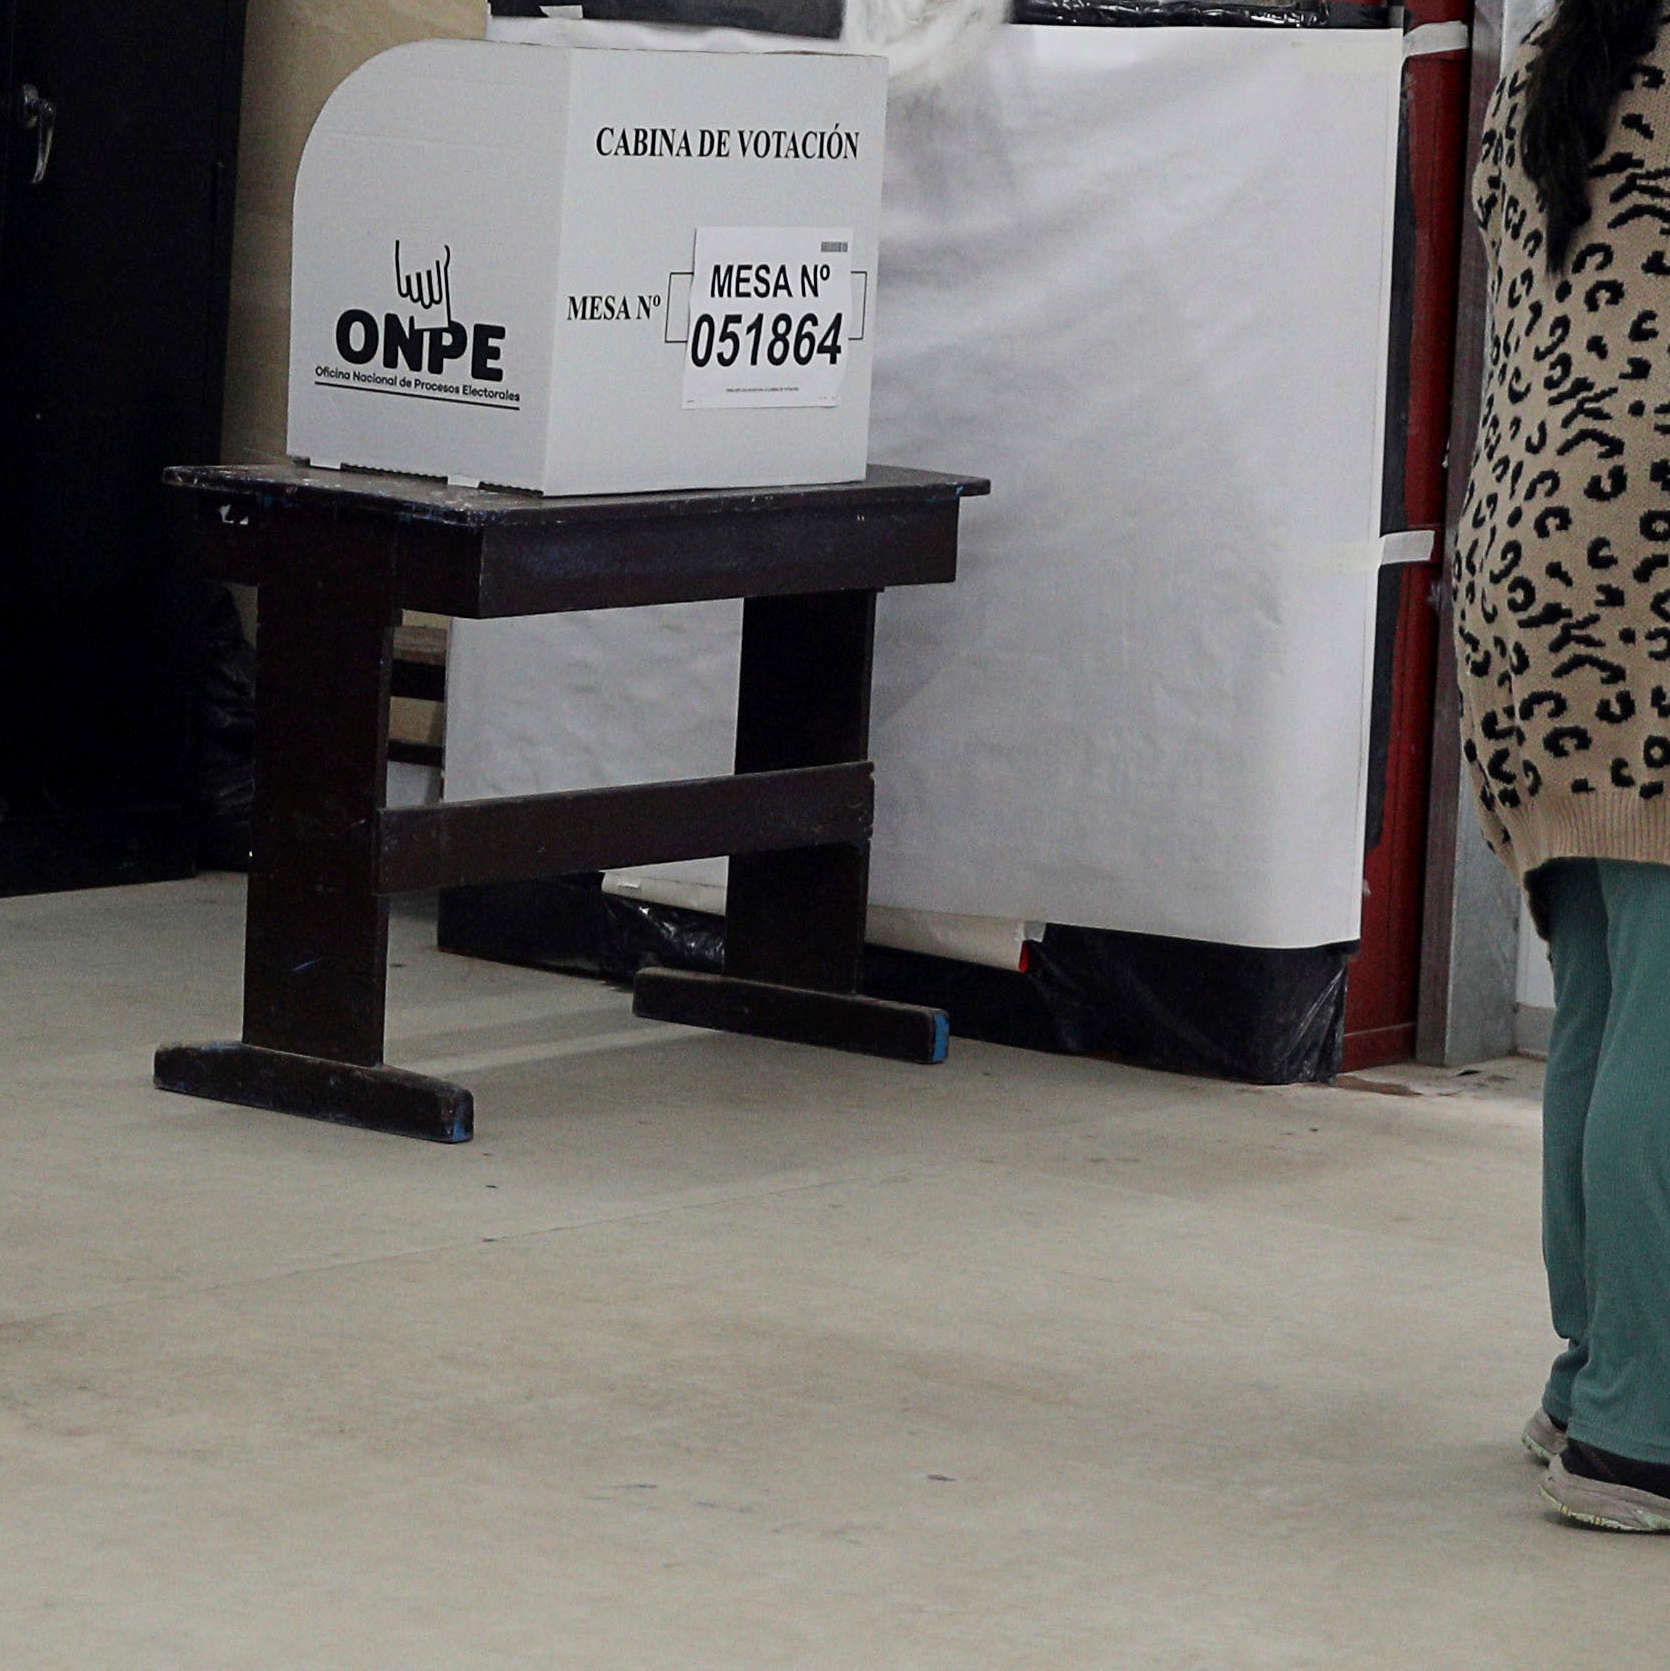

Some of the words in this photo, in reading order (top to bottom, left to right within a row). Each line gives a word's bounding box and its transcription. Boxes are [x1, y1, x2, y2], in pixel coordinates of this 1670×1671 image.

[595, 127, 692, 158] CABINA
[697, 128, 730, 158] DE
[738, 123, 859, 159] VOTACIÓN
[710, 263, 793, 299] MESA
[567, 295, 631, 321] MESA
[335, 308, 506, 382] ONPE
[691, 312, 843, 368] 051864
[315, 365, 351, 380] Oficina
[352, 371, 397, 386] Nacional
[399, 377, 412, 389] de
[414, 380, 460, 395] Procesos
[462, 384, 520, 402] Electorales
